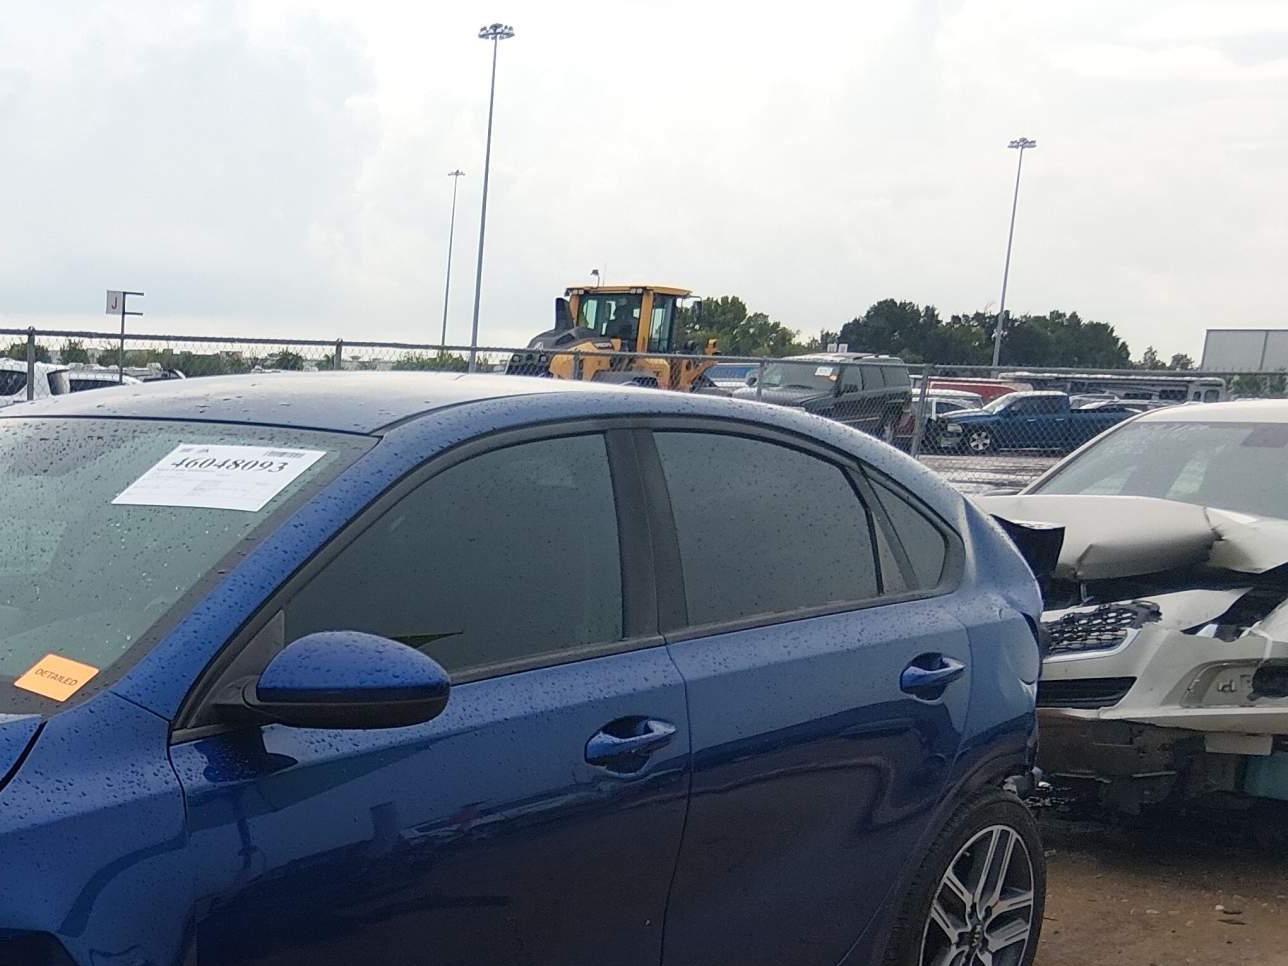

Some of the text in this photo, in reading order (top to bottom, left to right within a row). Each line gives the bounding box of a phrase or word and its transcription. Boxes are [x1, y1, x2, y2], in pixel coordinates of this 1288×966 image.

[111, 296, 118, 310] J
[170, 457, 289, 473] 46048093
[34, 668, 79, 687] DETAILED
